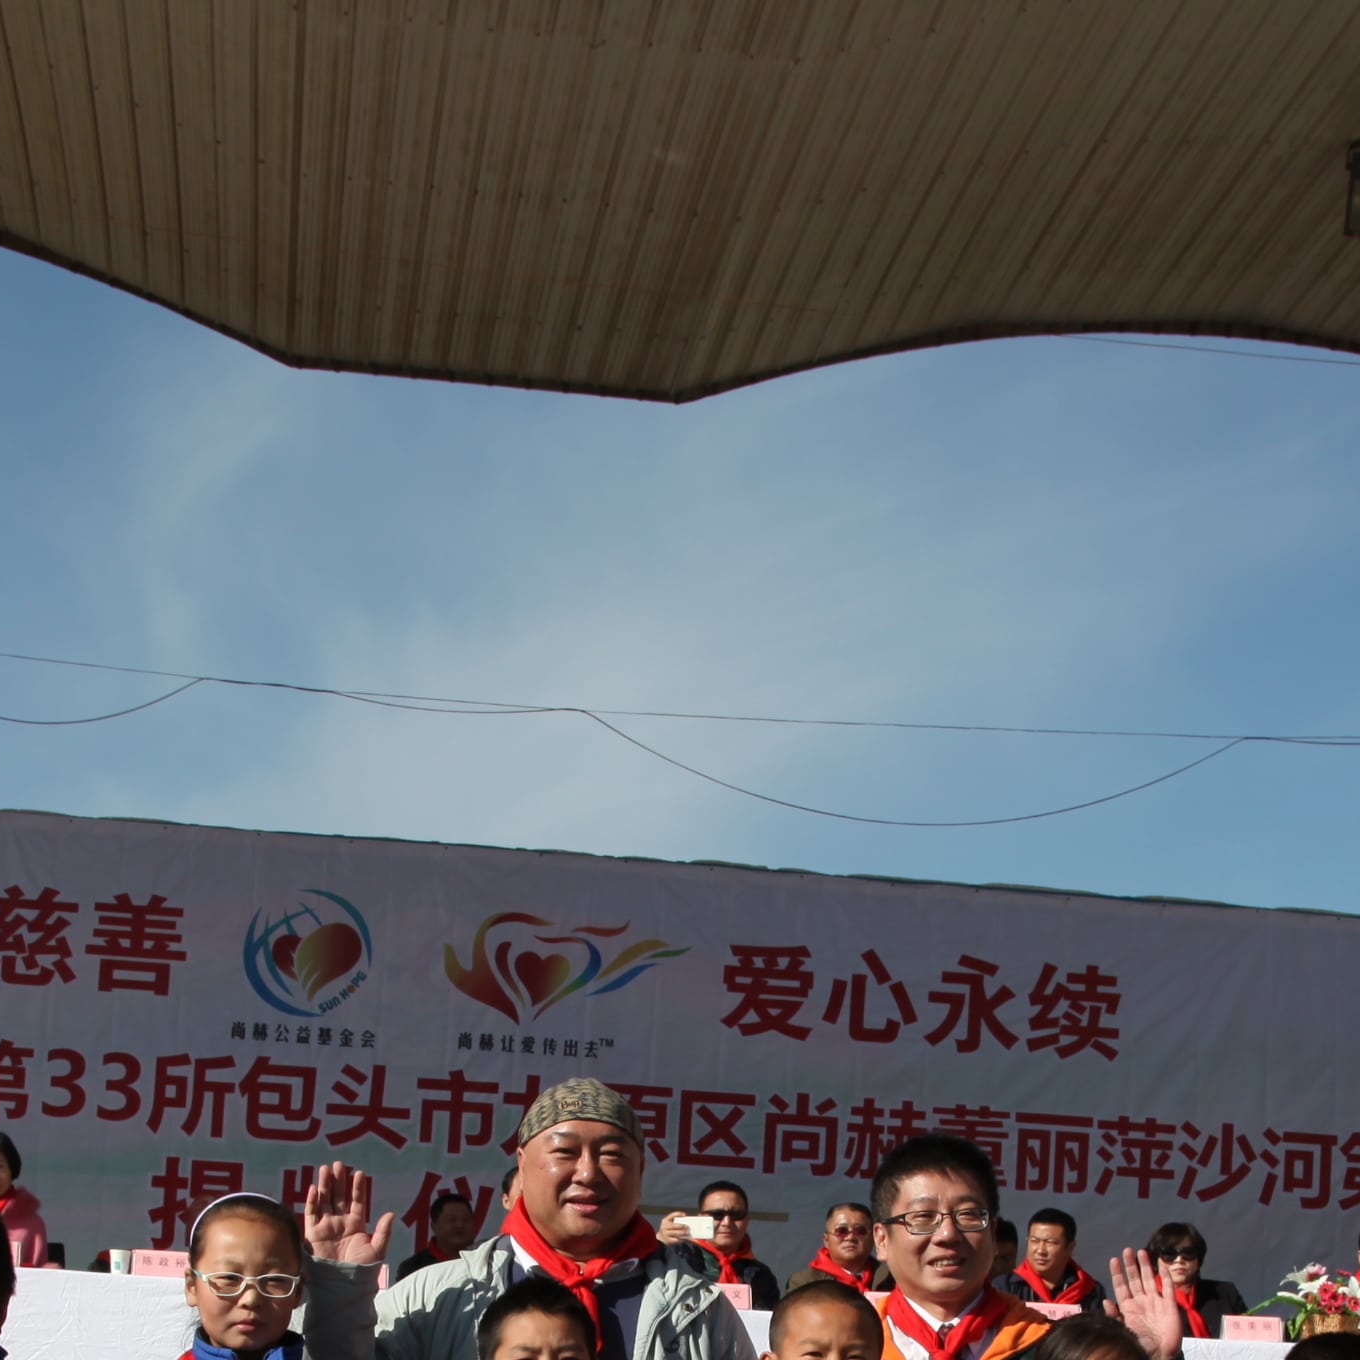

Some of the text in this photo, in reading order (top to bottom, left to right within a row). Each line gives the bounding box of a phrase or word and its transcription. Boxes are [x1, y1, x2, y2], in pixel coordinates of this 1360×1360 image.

[231, 1021, 376, 1048] 尚赫公益基金会
[721, 942, 1123, 1062] 爱心永续
